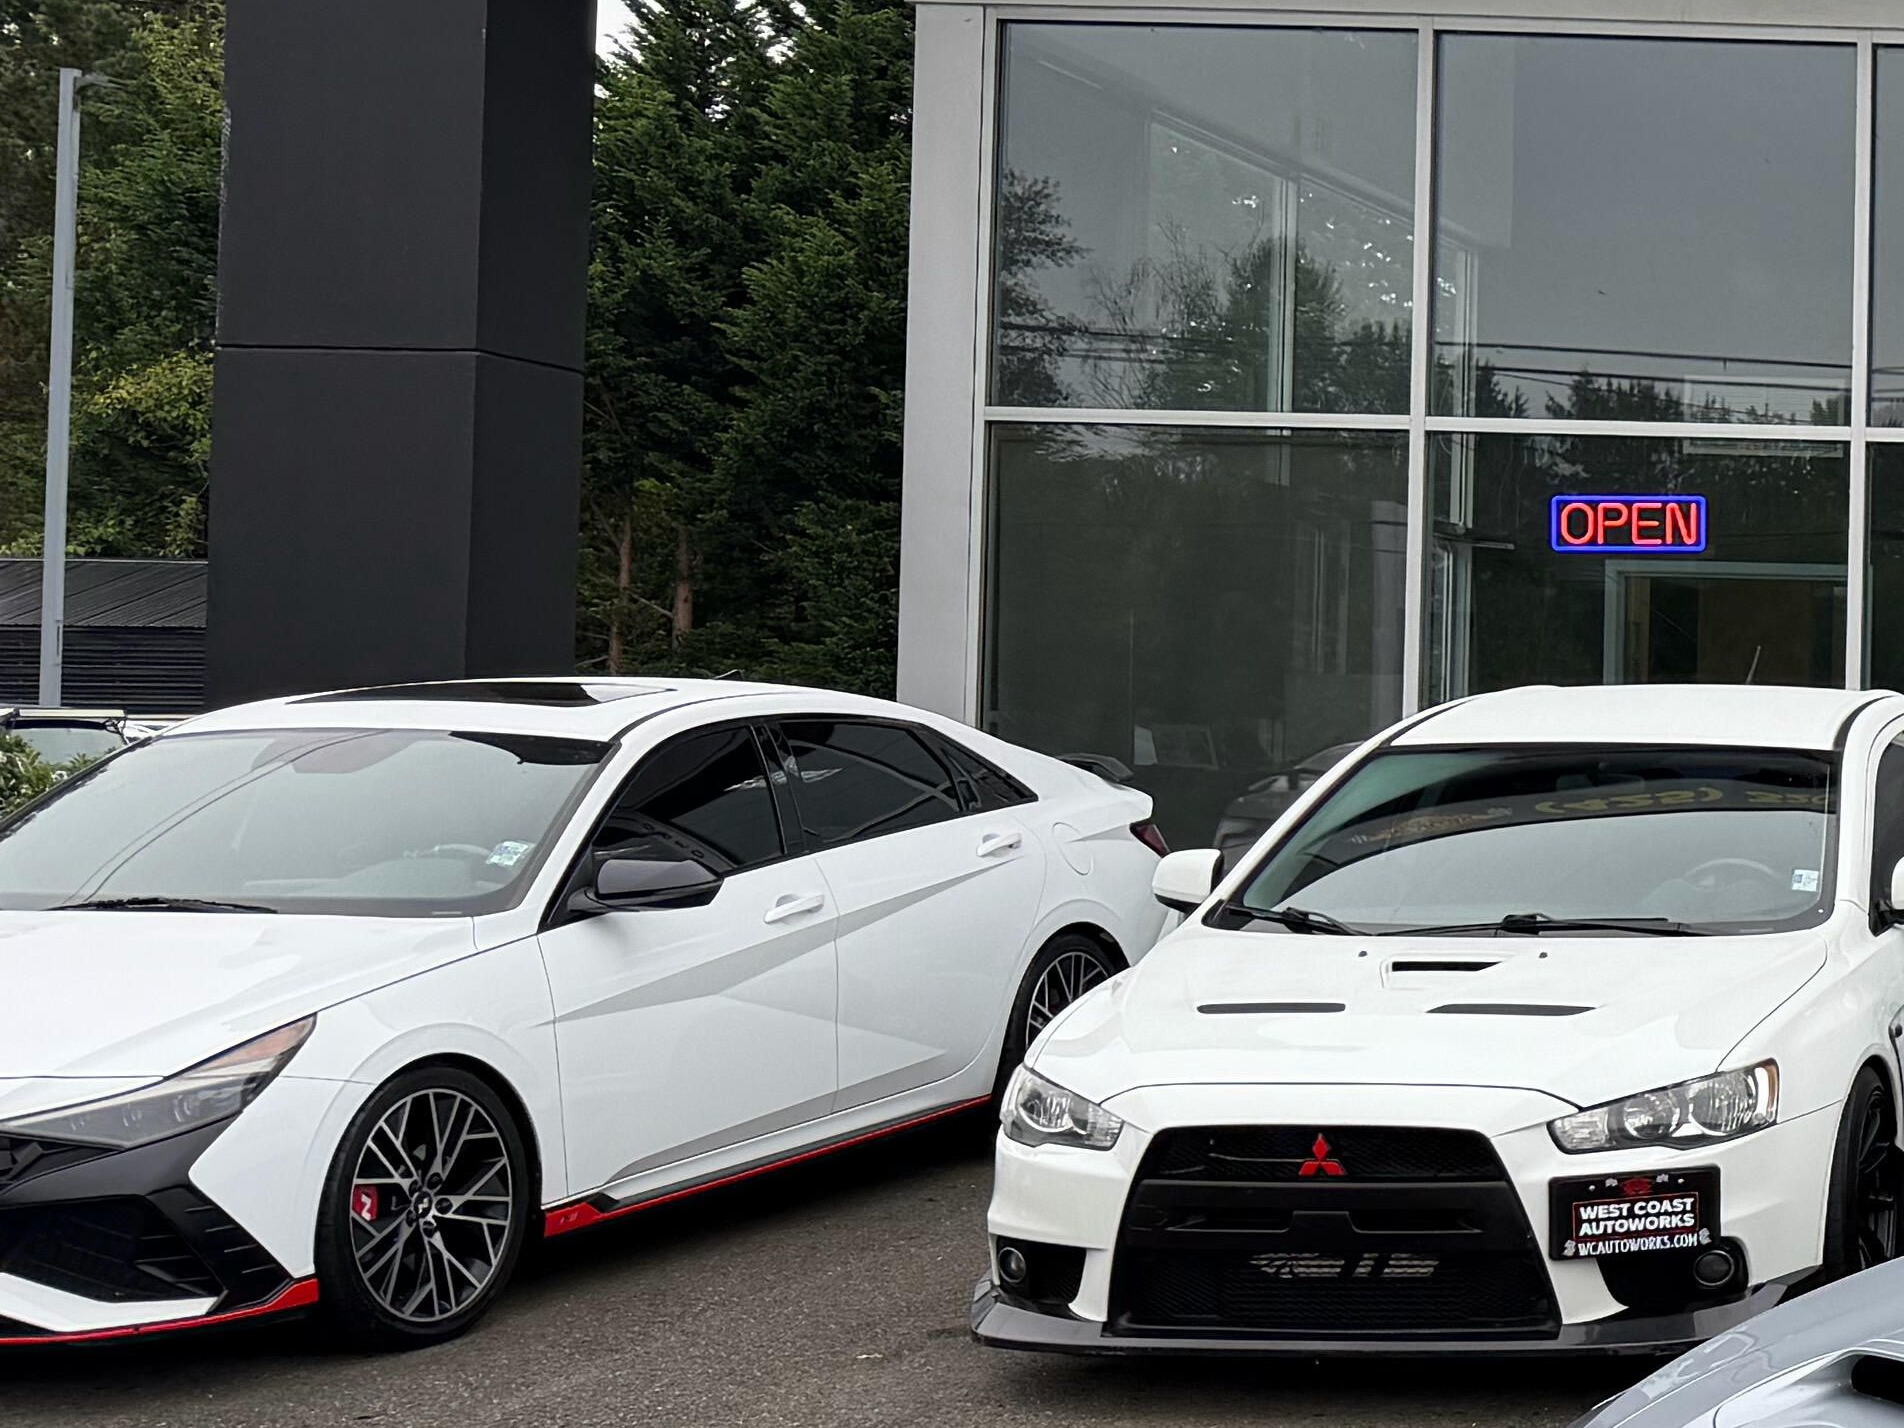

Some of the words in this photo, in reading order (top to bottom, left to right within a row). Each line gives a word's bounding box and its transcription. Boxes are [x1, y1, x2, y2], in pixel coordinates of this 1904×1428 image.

[1560, 502, 1697, 545] OPEN
[1580, 1202, 1632, 1220] WEST
[1633, 1197, 1695, 1215] COAST
[1579, 1213, 1695, 1237] AUTOWORKS
[1577, 1233, 1698, 1257] WCAUTOWORKS.COM
